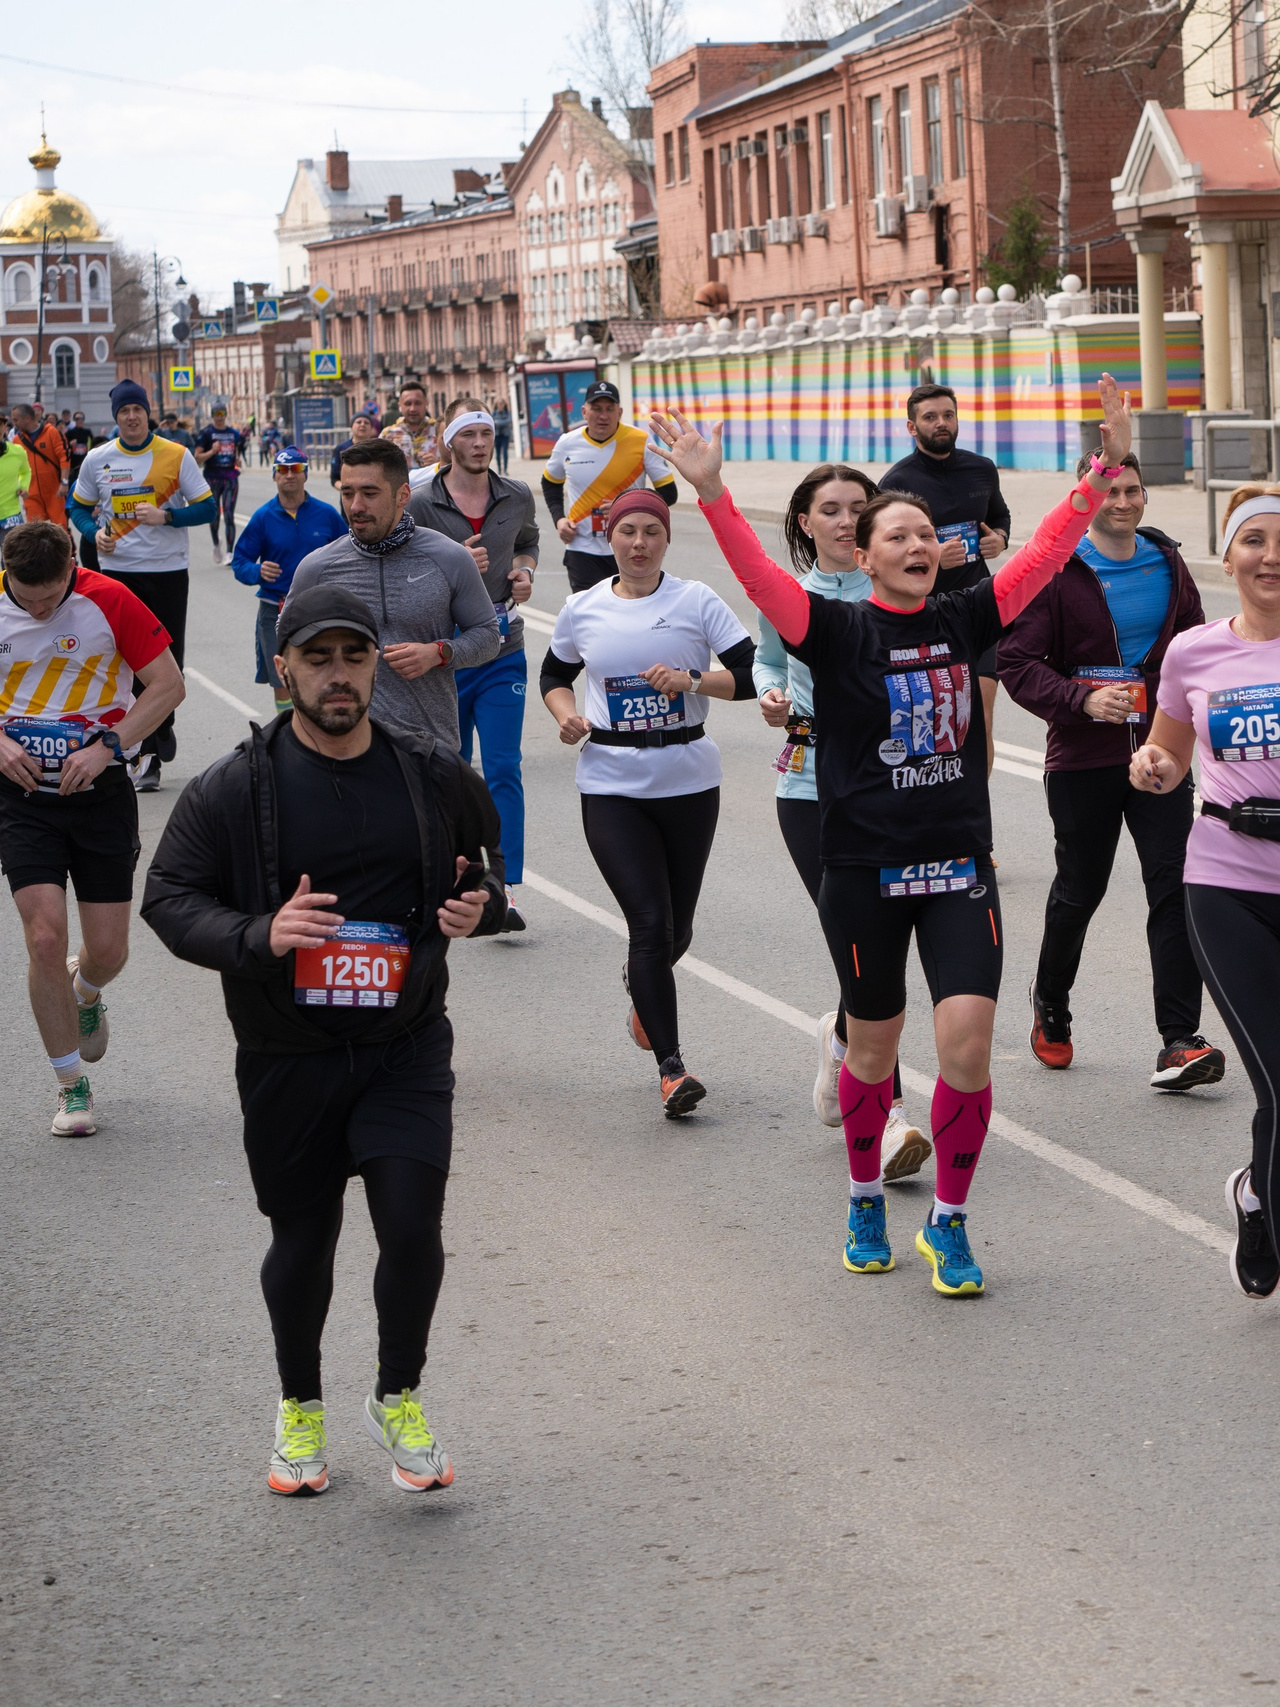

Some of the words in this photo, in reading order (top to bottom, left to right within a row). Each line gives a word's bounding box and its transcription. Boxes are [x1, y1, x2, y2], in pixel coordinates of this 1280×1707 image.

[890, 643, 951, 662] IRONMAN
[918, 670, 931, 693] BIKE
[939, 667, 953, 689] RUN
[960, 663, 971, 689] NICE
[897, 673, 911, 702] SWIM
[1239, 691, 1280, 701] КОСМОС
[1245, 686, 1280, 695] ПРОСТО
[622, 693, 670, 719] 2359
[1243, 703, 1274, 711] НАТАЛЬЯ
[19, 735, 67, 757] 2309
[892, 758, 964, 790] FINISHER
[341, 943, 366, 951] ЛЕВОН
[322, 955, 388, 988] 1250
[393, 961, 401, 971] E
